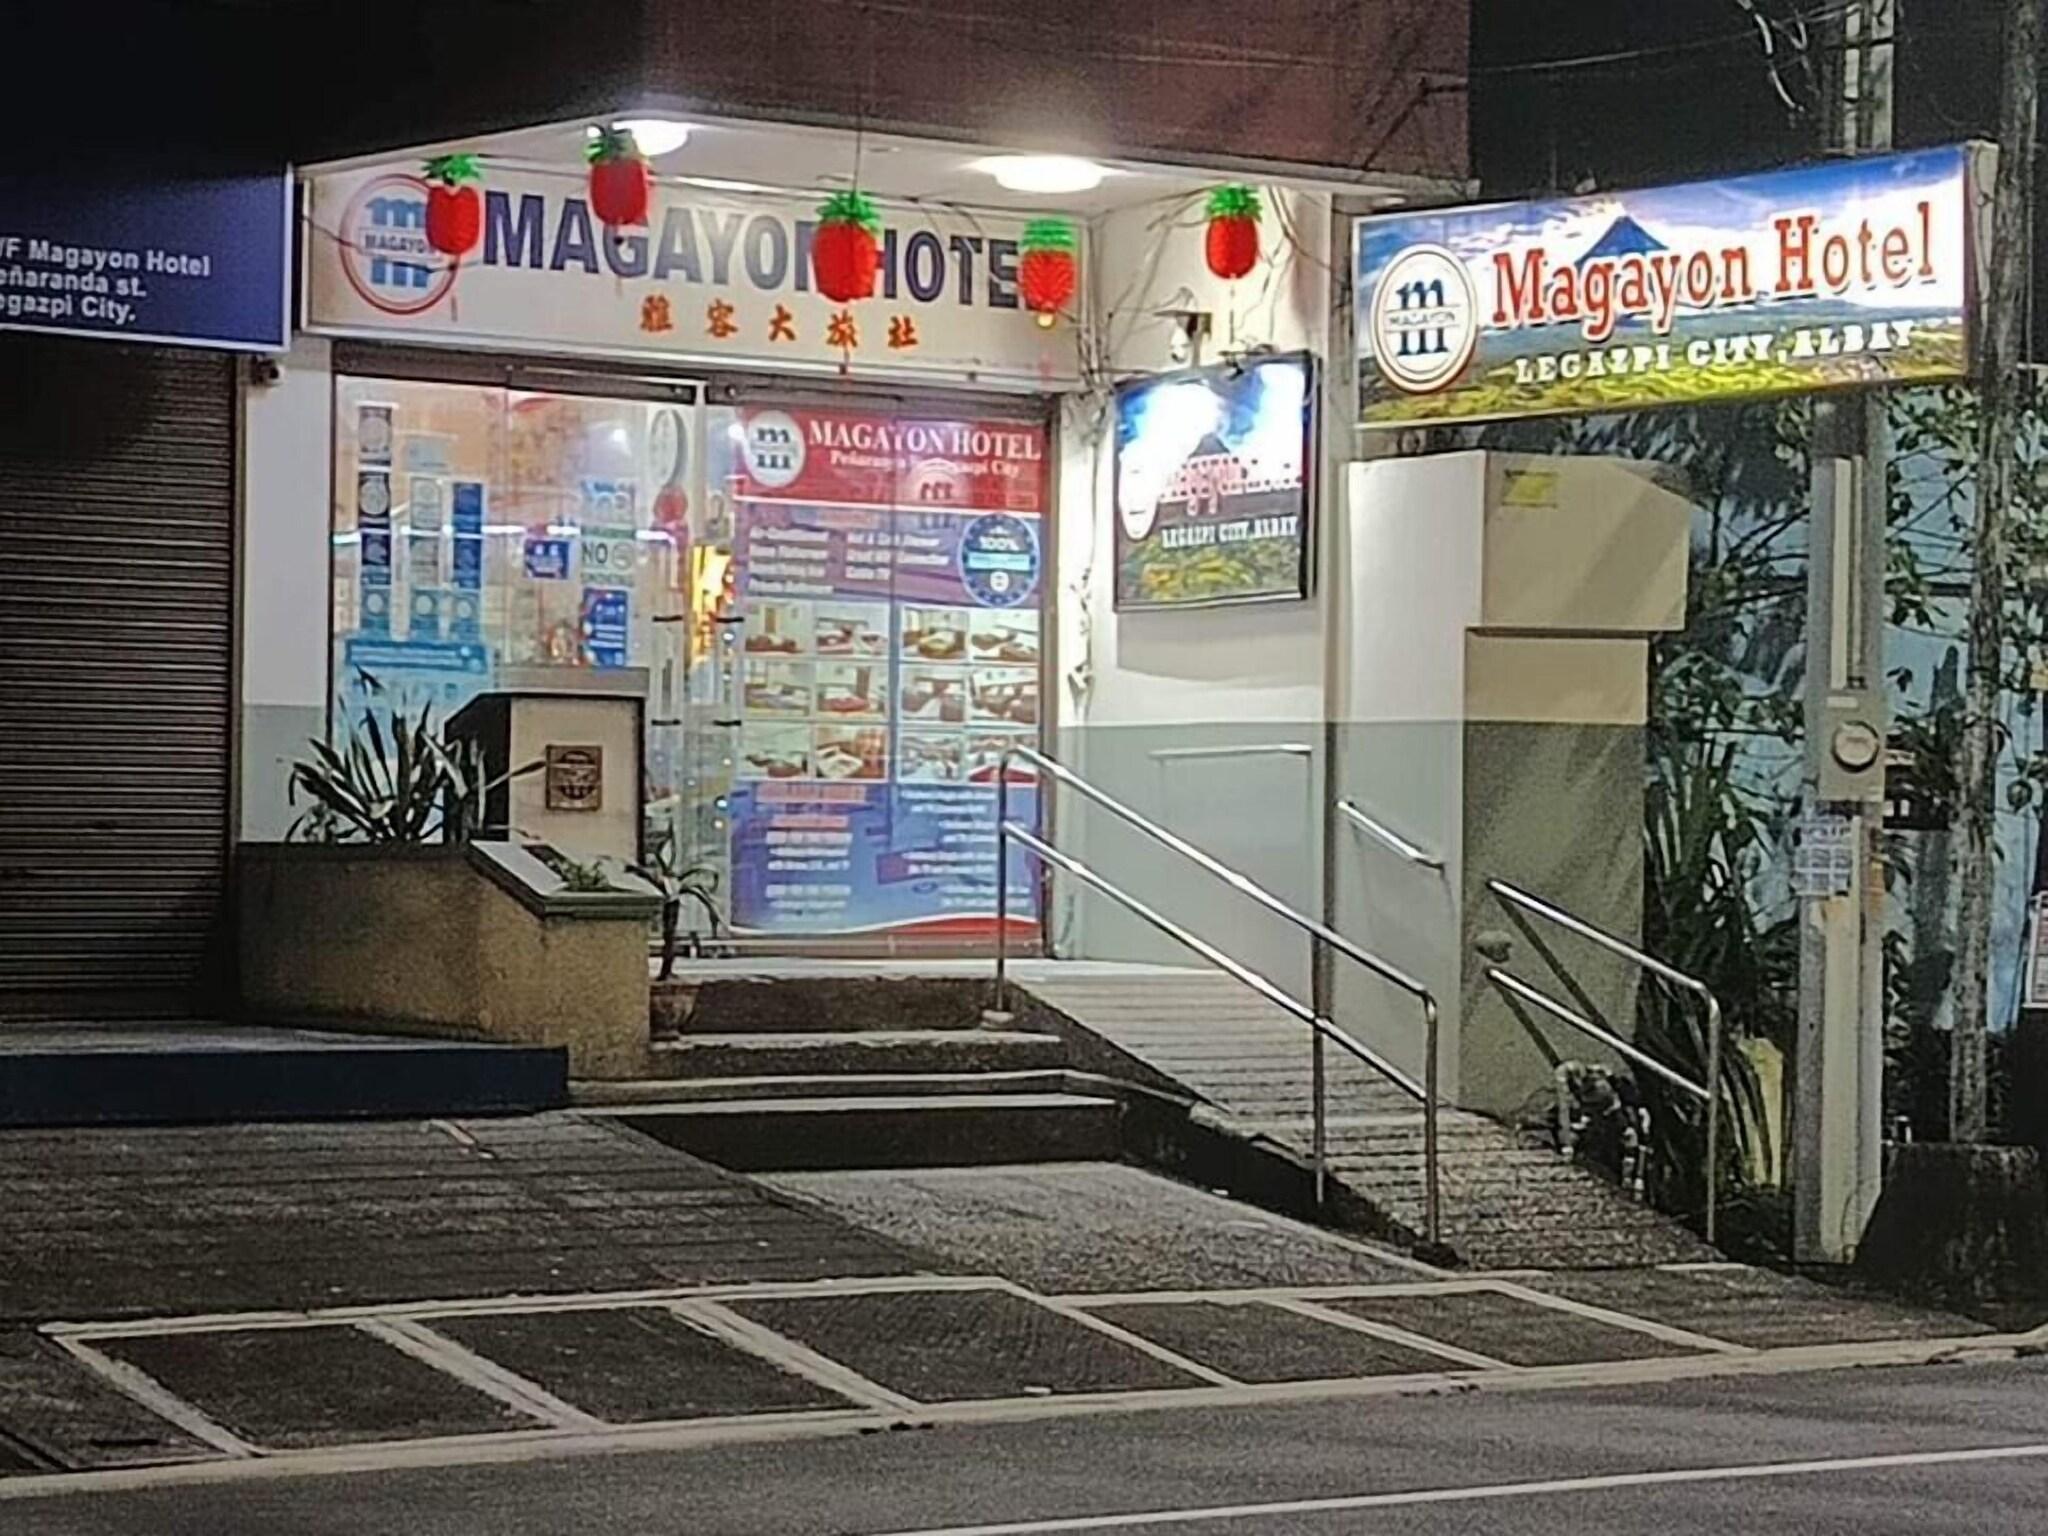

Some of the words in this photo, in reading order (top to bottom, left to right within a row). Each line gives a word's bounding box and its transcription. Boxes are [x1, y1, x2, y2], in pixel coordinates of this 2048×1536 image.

[28, 240, 139, 271] Magayon
[146, 249, 210, 277] Hotel
[364, 234, 428, 253] MAGAYO
[876, 228, 1022, 310] OTE
[1491, 246, 1753, 338] Magayon
[1773, 201, 1933, 293] Hotel
[1513, 344, 1671, 383] LEGAZPI
[952, 430, 1042, 461] HOTEL
